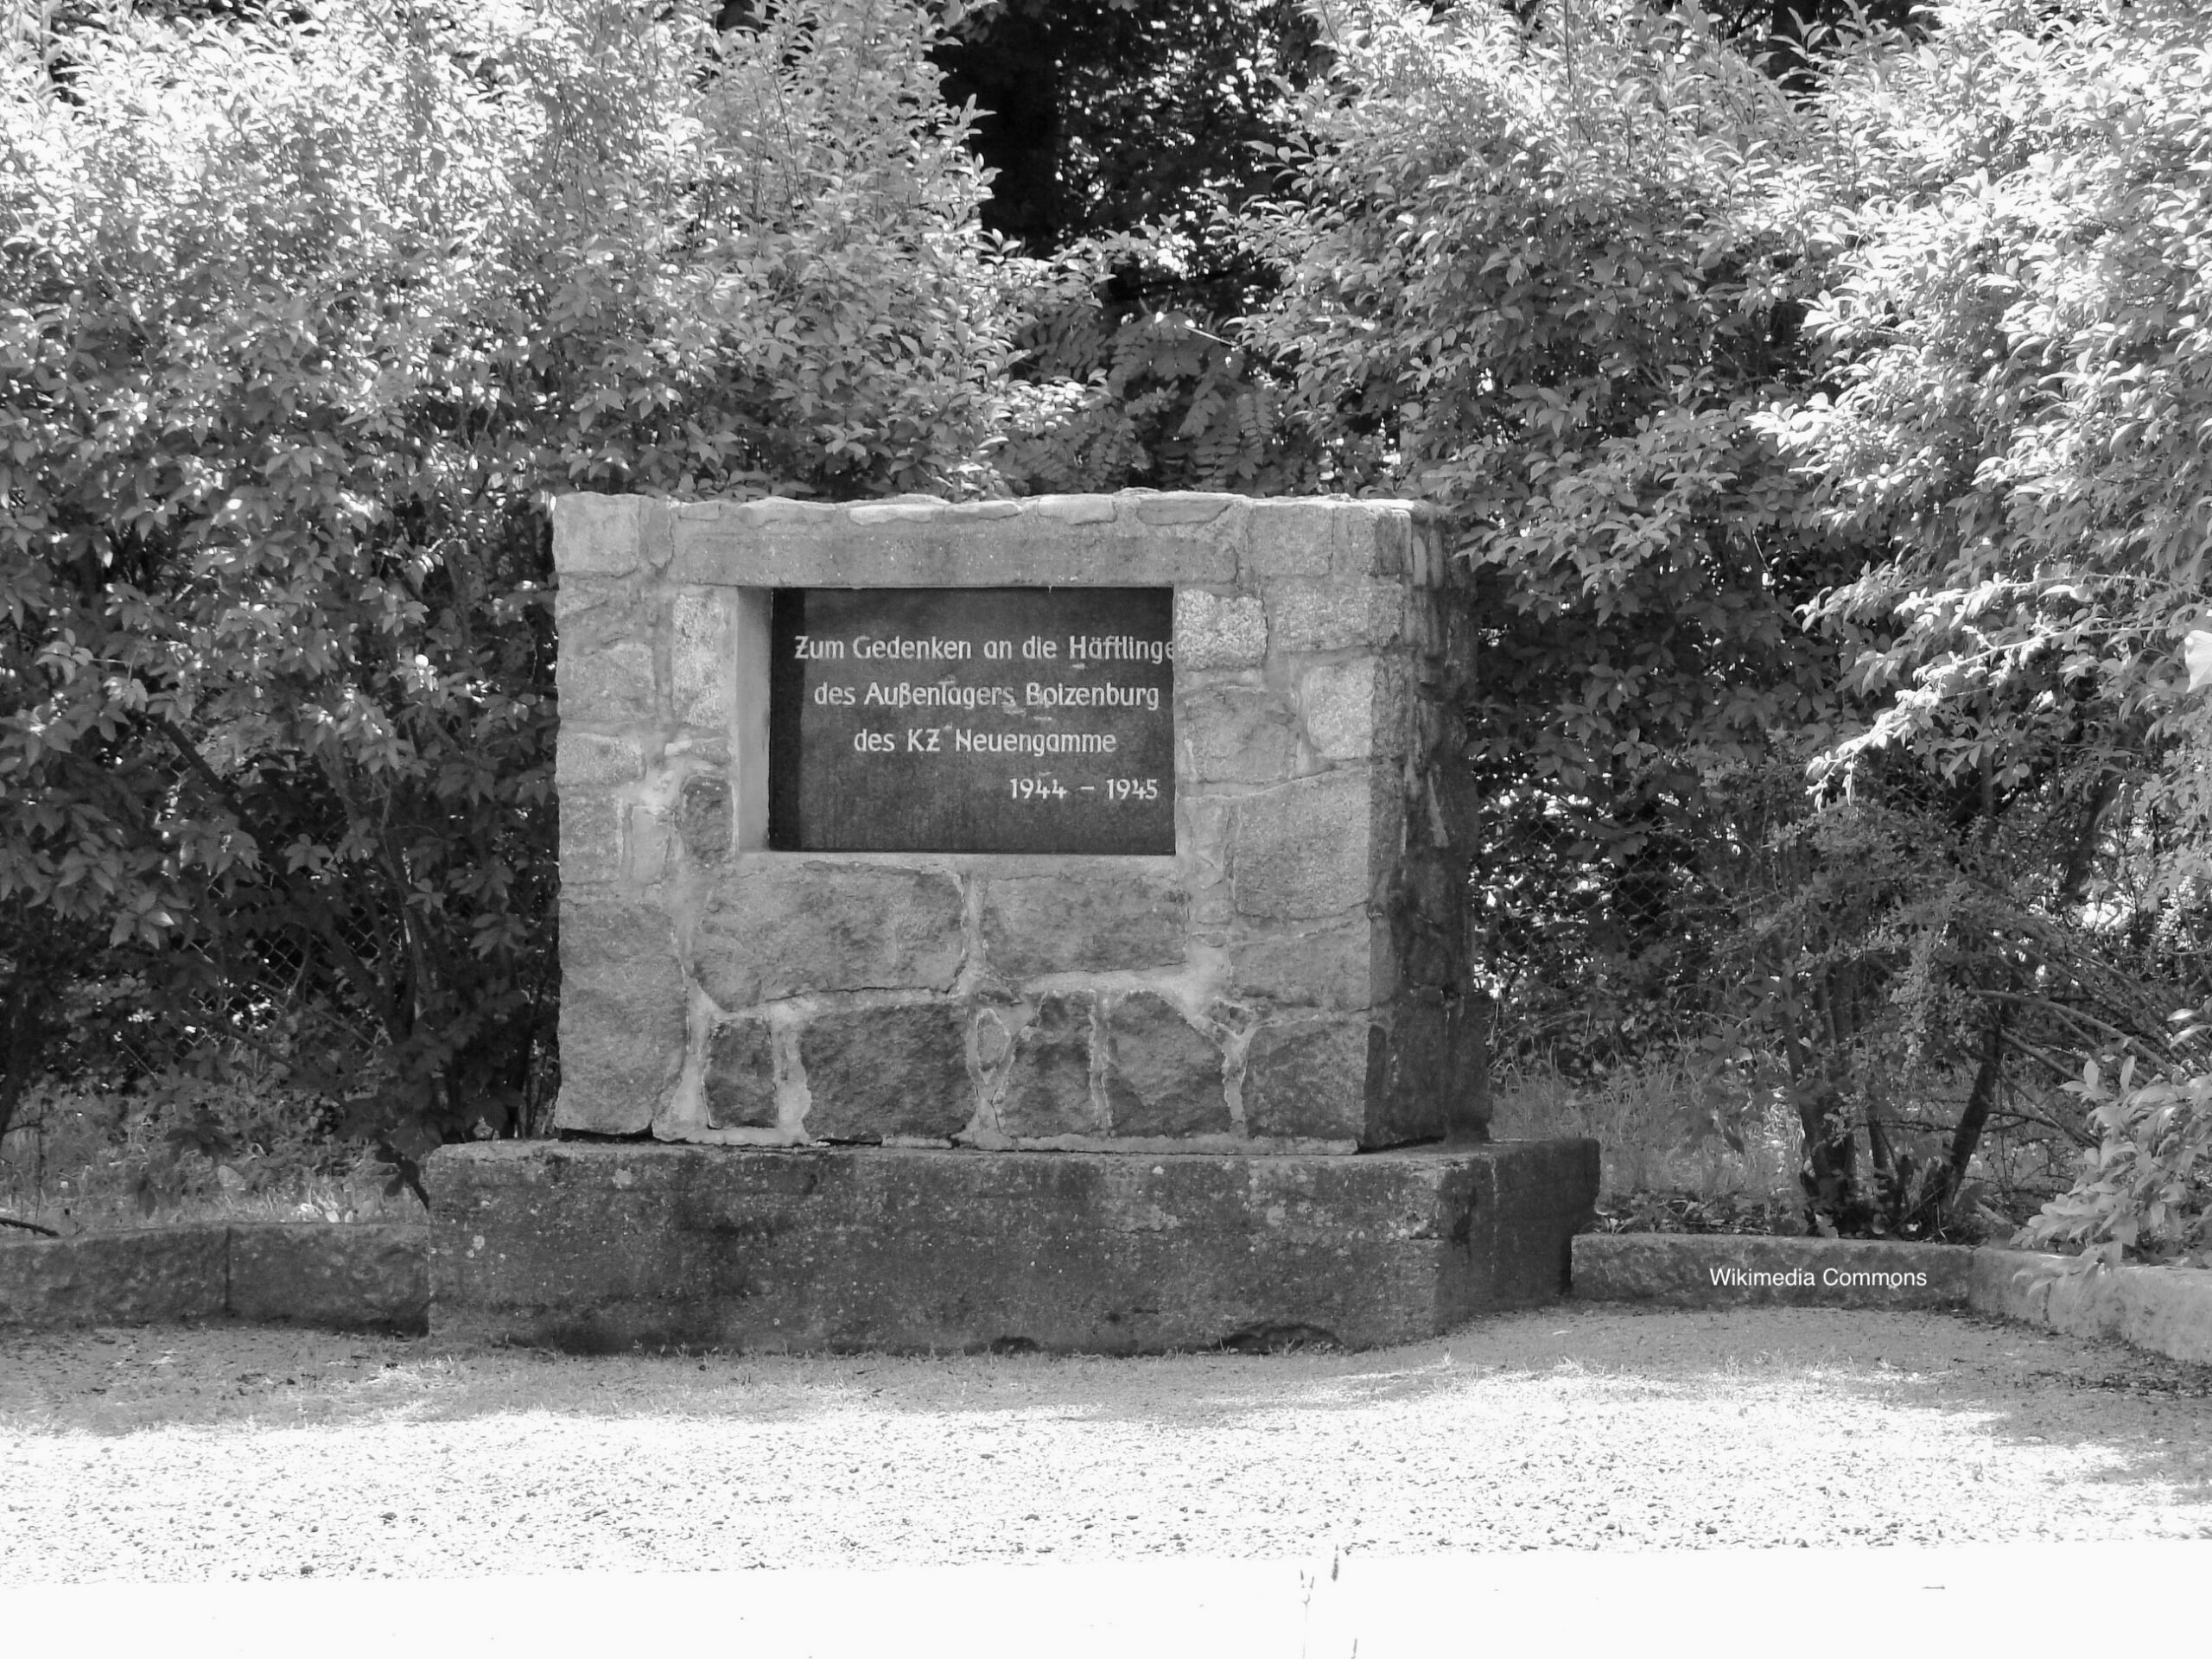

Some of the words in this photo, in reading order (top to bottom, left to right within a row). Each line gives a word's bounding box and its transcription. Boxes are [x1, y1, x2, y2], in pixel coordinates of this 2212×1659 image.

[794, 635, 845, 660] Zum
[852, 635, 972, 660] Gedenken
[983, 640, 1013, 660] an
[1021, 635, 1058, 660] die
[814, 681, 856, 706] des
[863, 681, 1018, 710] Außenlagers
[1025, 681, 1160, 711] Boizenburg
[854, 728, 896, 753] des
[907, 728, 942, 753] KZ
[955, 728, 1117, 757] Neuengamme
[1009, 778, 1068, 800] 1944
[1105, 778, 1159, 800] 1945
